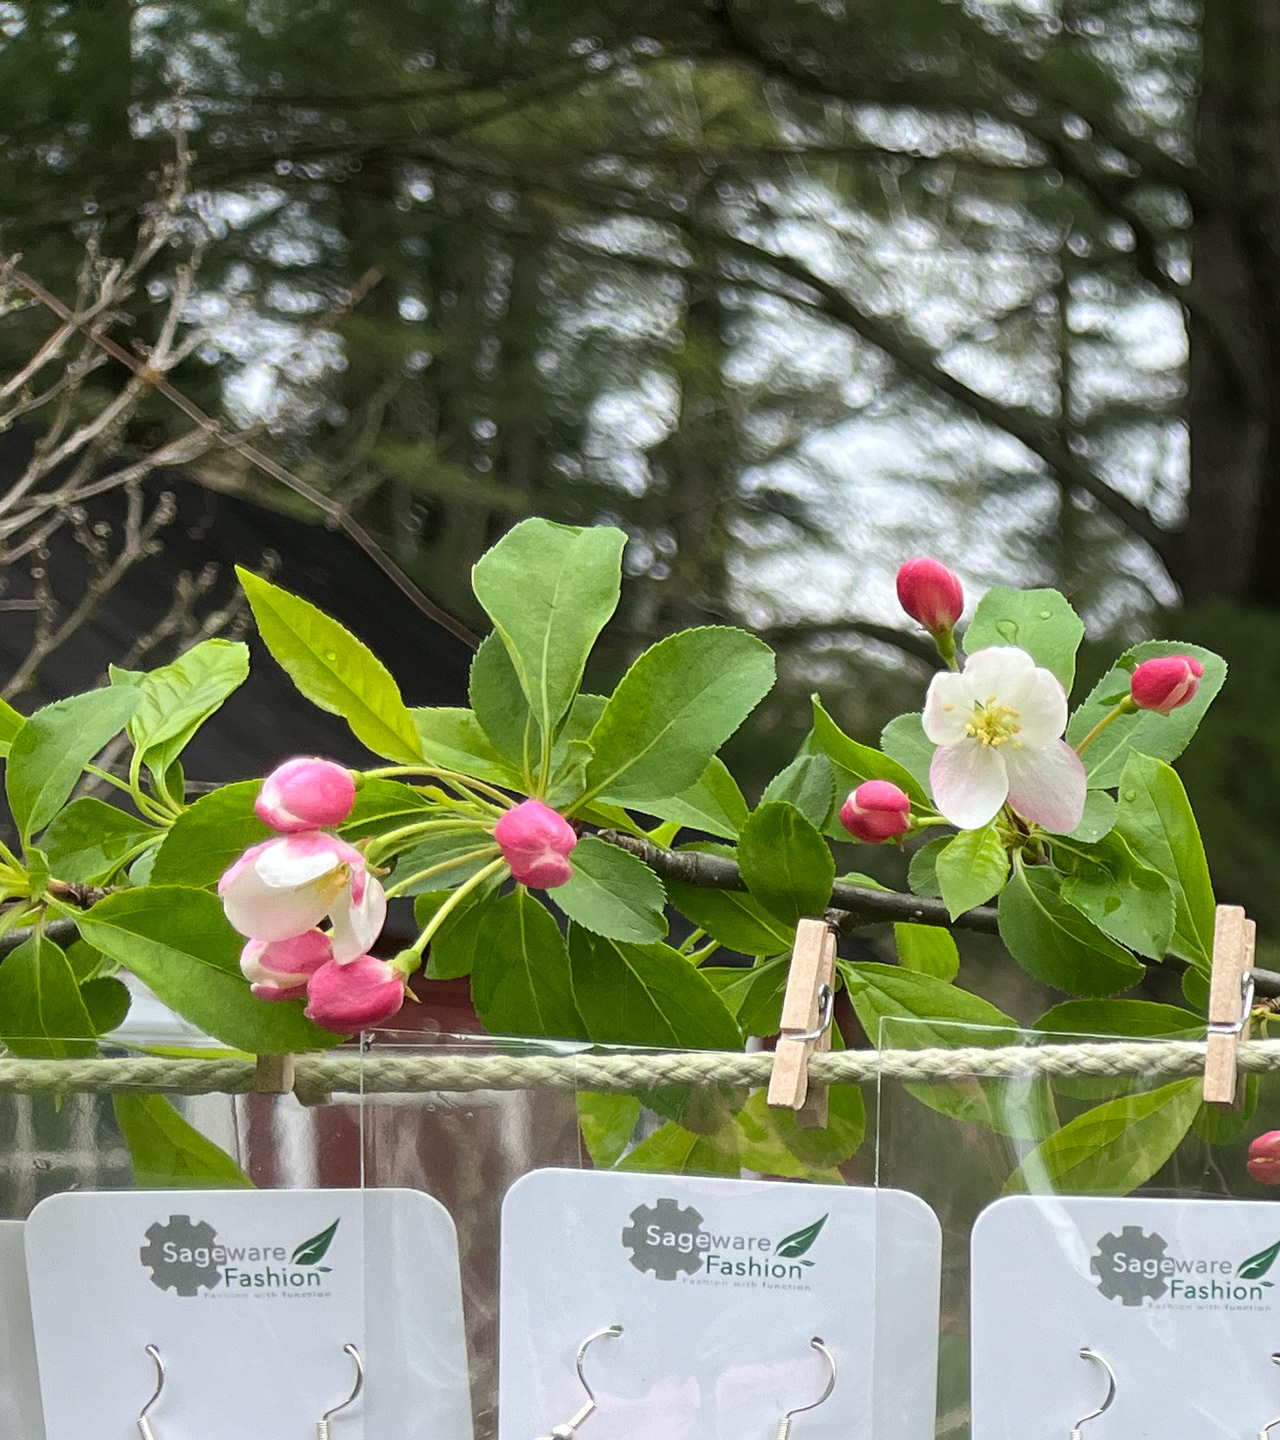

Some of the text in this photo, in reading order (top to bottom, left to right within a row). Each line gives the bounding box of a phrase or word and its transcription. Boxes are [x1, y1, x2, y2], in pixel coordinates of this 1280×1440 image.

[646, 1225, 771, 1253] Sageware
[163, 1242, 286, 1267] Sageware
[1113, 1252, 1232, 1279] Sageware
[225, 1266, 321, 1288] Fashion
[706, 1255, 802, 1279] Fashion
[1171, 1279, 1262, 1300] Fashion
